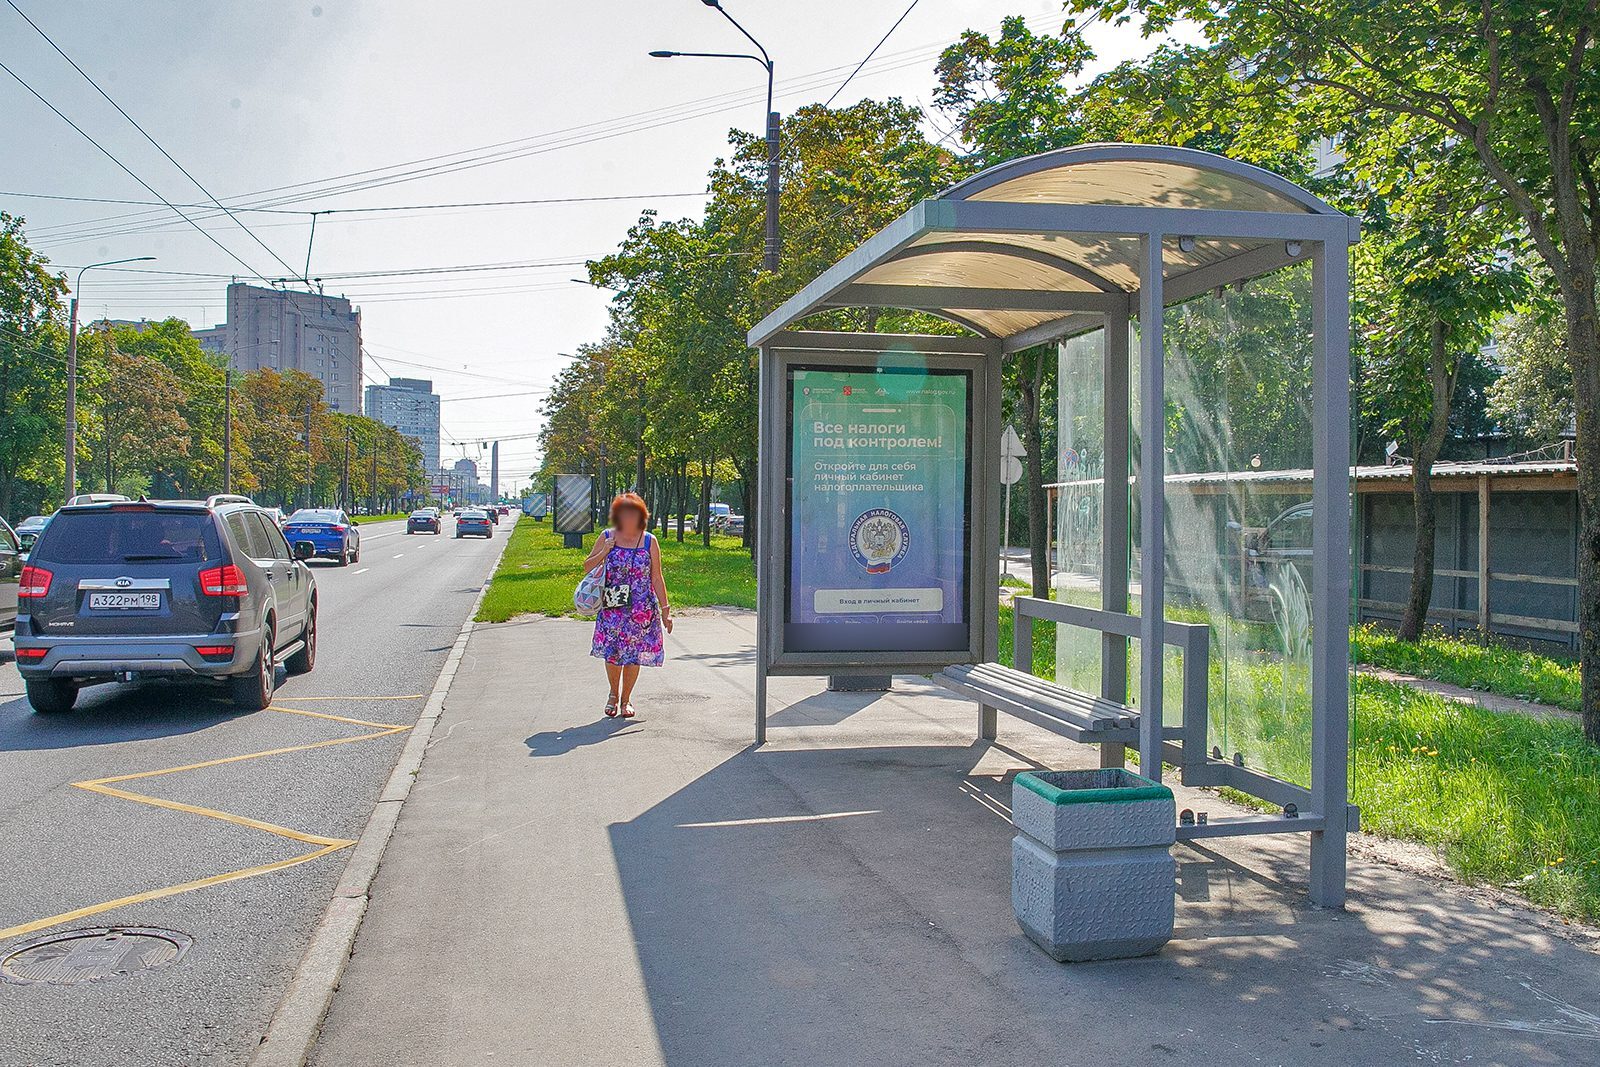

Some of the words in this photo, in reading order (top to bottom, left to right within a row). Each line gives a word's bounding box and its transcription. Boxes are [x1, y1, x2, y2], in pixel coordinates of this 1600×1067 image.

[813, 422, 843, 434] Все
[848, 423, 906, 435] налоги
[814, 437, 845, 448] под
[848, 436, 942, 450] контролем!
[814, 461, 866, 472] Откройте
[868, 463, 889, 472] для
[891, 461, 916, 471] себя
[814, 471, 857, 481] личный
[860, 472, 904, 481] кабинет
[814, 482, 924, 493] налогоплательщика
[870, 510, 906, 530] НАЛОГОВАЯ
[897, 532, 909, 558] СЛУЖБА
[93, 595, 138, 606] А322РМ
[140, 595, 156, 603] 198
